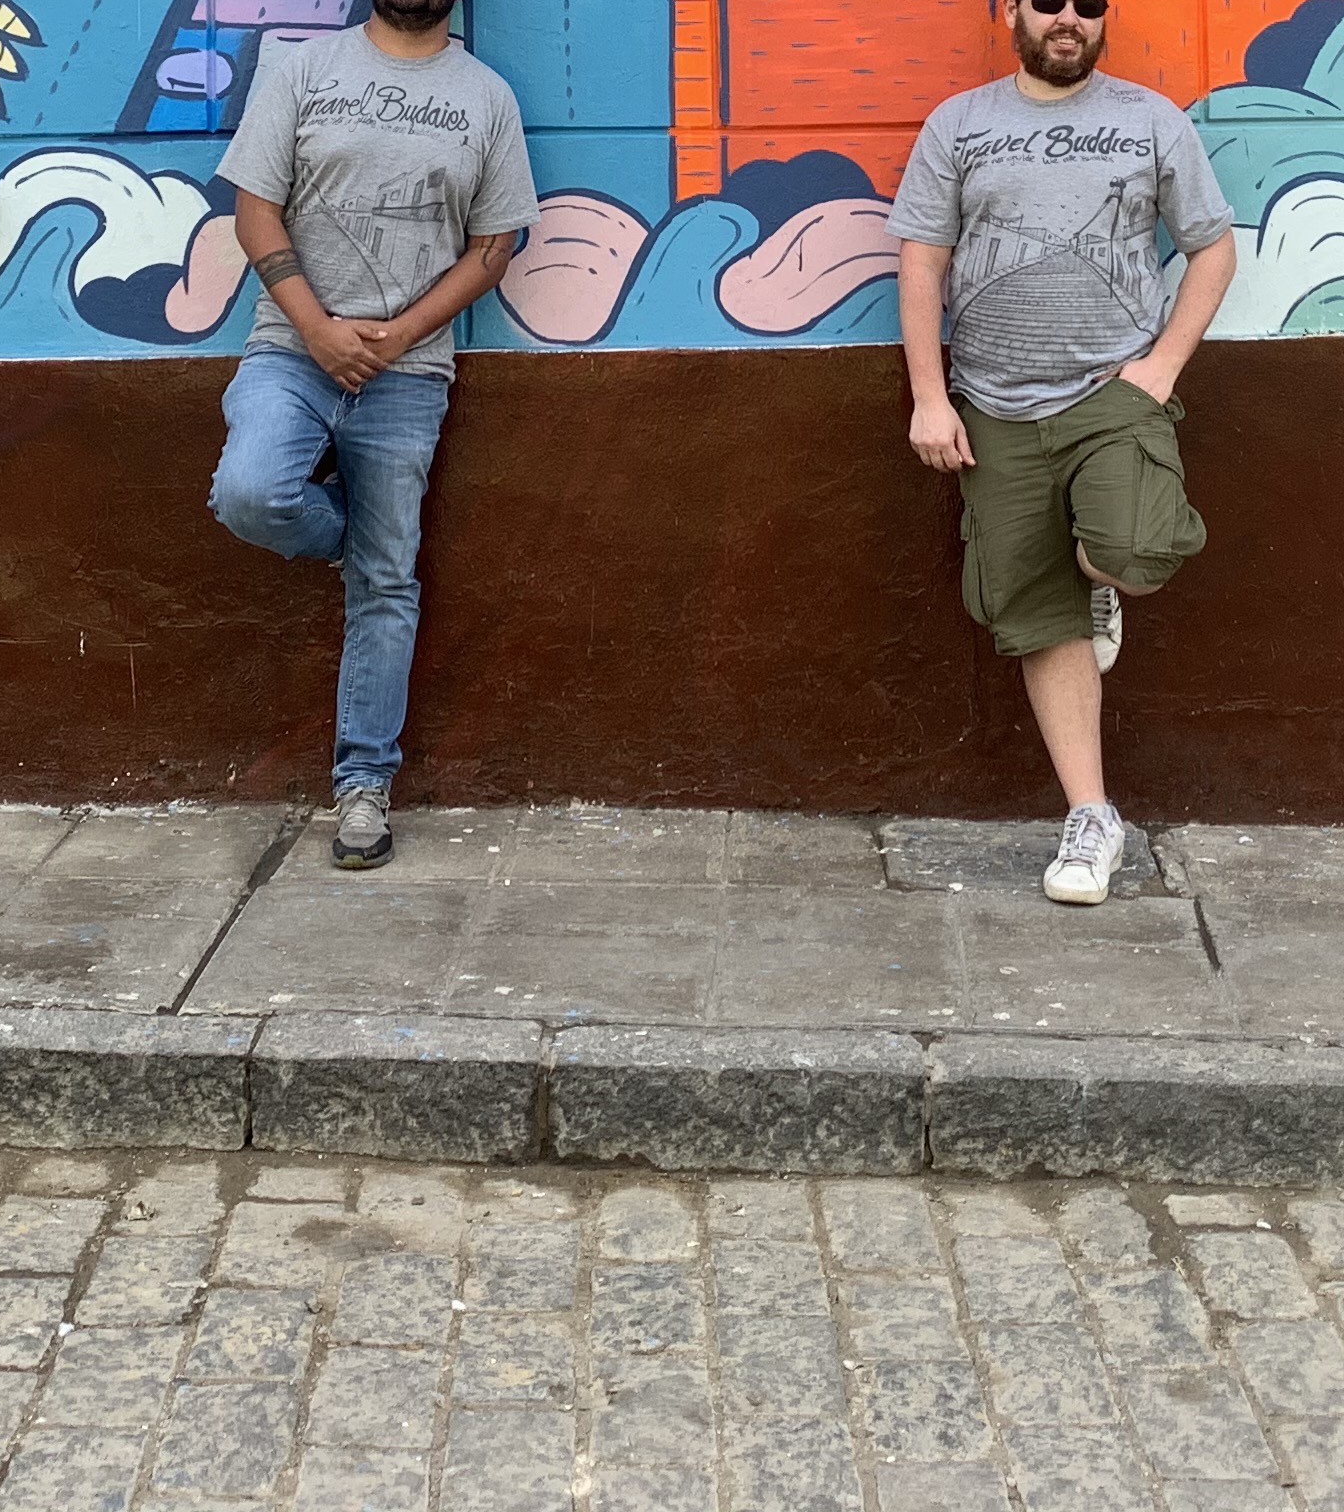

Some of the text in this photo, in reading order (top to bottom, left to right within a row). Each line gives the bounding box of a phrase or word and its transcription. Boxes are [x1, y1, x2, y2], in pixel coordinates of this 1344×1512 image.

[300, 79, 375, 118] Travel
[954, 124, 1153, 165] Travel Buddies
